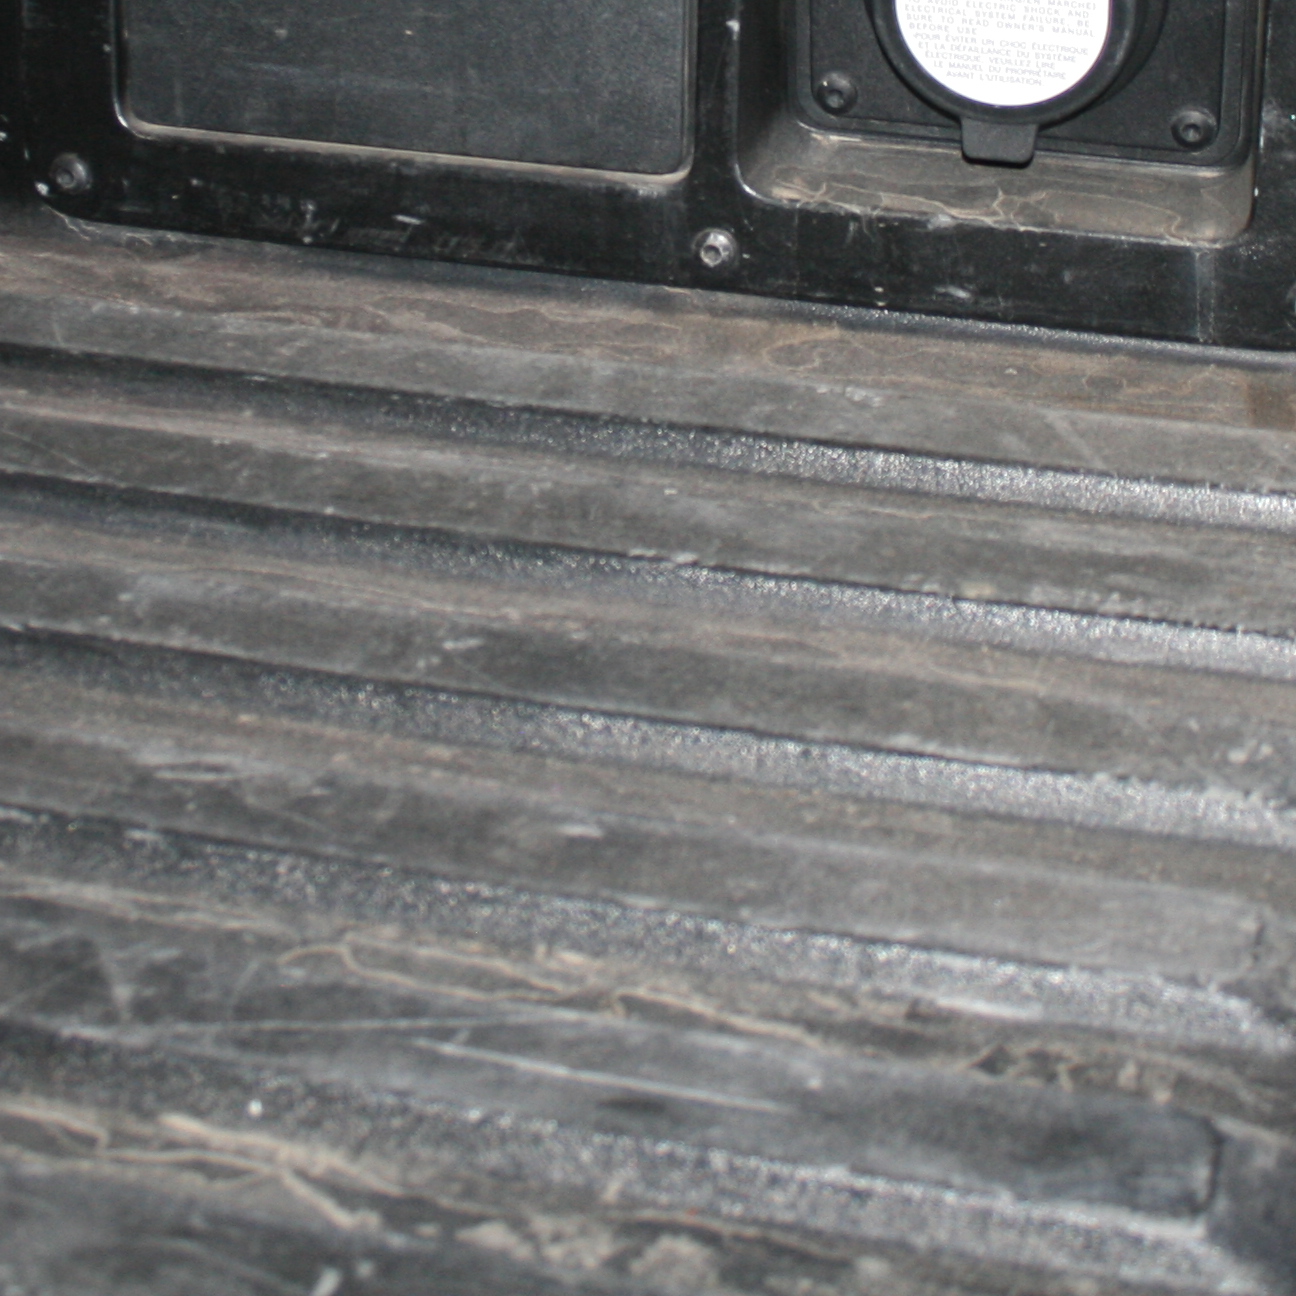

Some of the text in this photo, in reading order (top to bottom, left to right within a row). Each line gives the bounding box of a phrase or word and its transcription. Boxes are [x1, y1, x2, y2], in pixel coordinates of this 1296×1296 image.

[965, 0, 1015, 12] ELECTRIC
[1024, 5, 1059, 15] SHOCK
[1067, 8, 1088, 17] AND
[904, 4, 966, 17] ELECTRICAL
[975, 10, 1015, 21] SYSTEM
[1077, 18, 1089, 27] BE
[906, 13, 932, 23] SURE
[941, 16, 954, 25] TO
[961, 17, 989, 27] READ
[908, 22, 949, 32] BEFORE
[918, 41, 929, 50] ET
[934, 42, 945, 51] LA
[934, 60, 943, 69] LE
